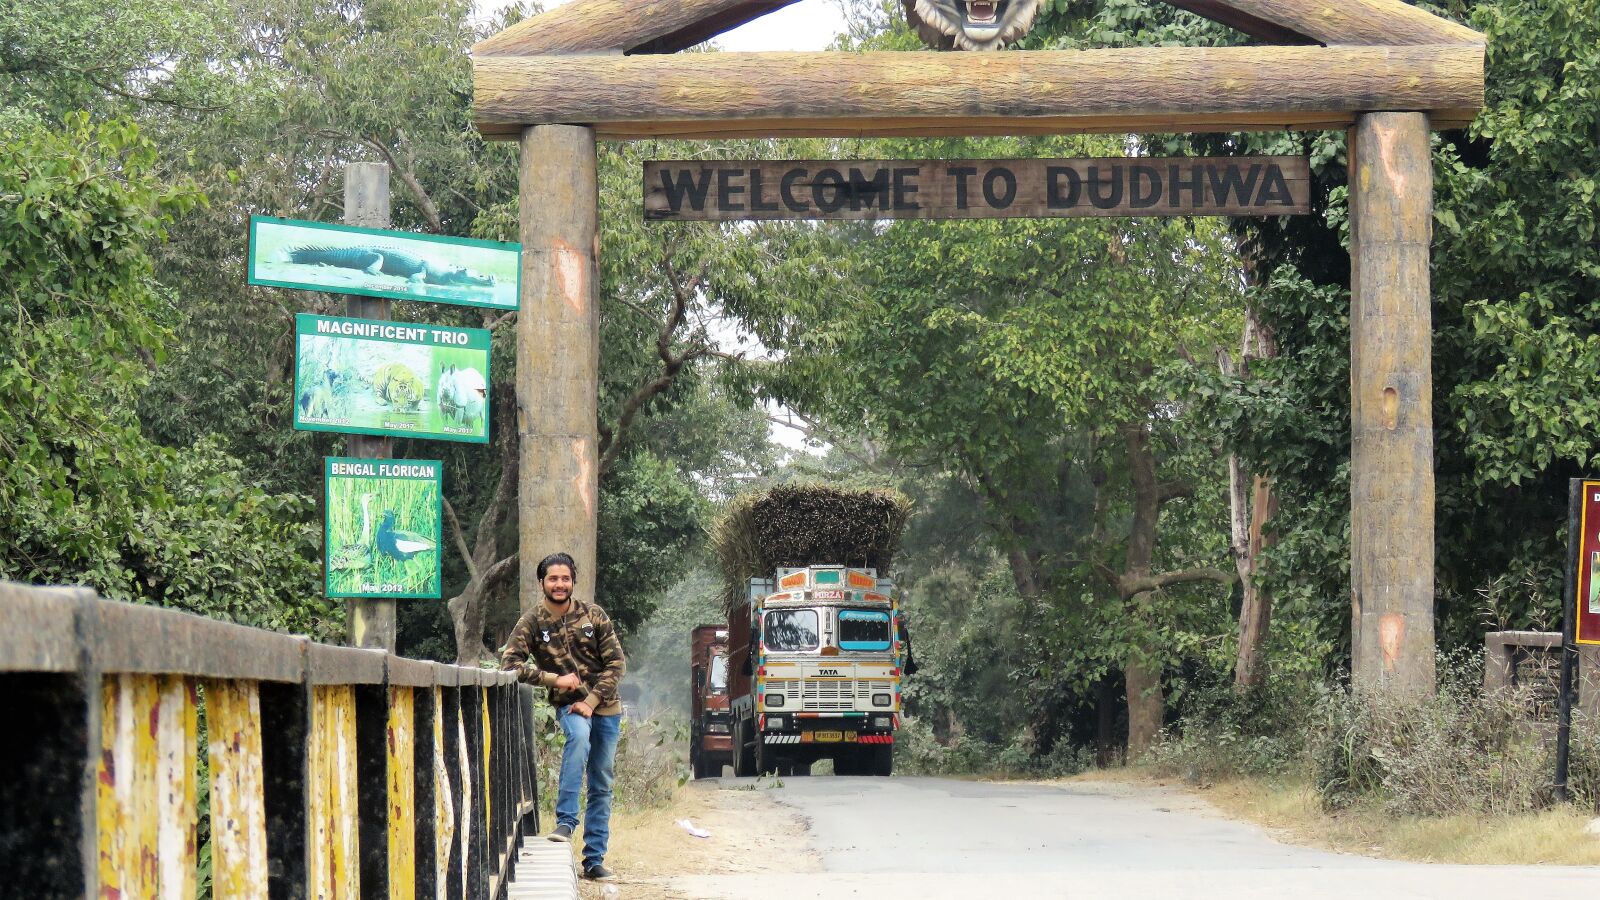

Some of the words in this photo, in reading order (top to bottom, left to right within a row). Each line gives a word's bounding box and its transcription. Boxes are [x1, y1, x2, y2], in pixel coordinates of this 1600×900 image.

[658, 167, 920, 213] WELCOME
[947, 166, 1018, 210] TO
[1046, 163, 1294, 211] DUDHWA
[317, 319, 427, 343] MAGNIFICENT
[431, 329, 468, 345] TRIO
[384, 421, 398, 430] May
[399, 422, 415, 430] 2017
[443, 426, 457, 434] May
[331, 463, 376, 476] BENGAL
[379, 464, 434, 478] FLORICAN
[362, 583, 380, 593] May
[382, 583, 403, 592] 2012
